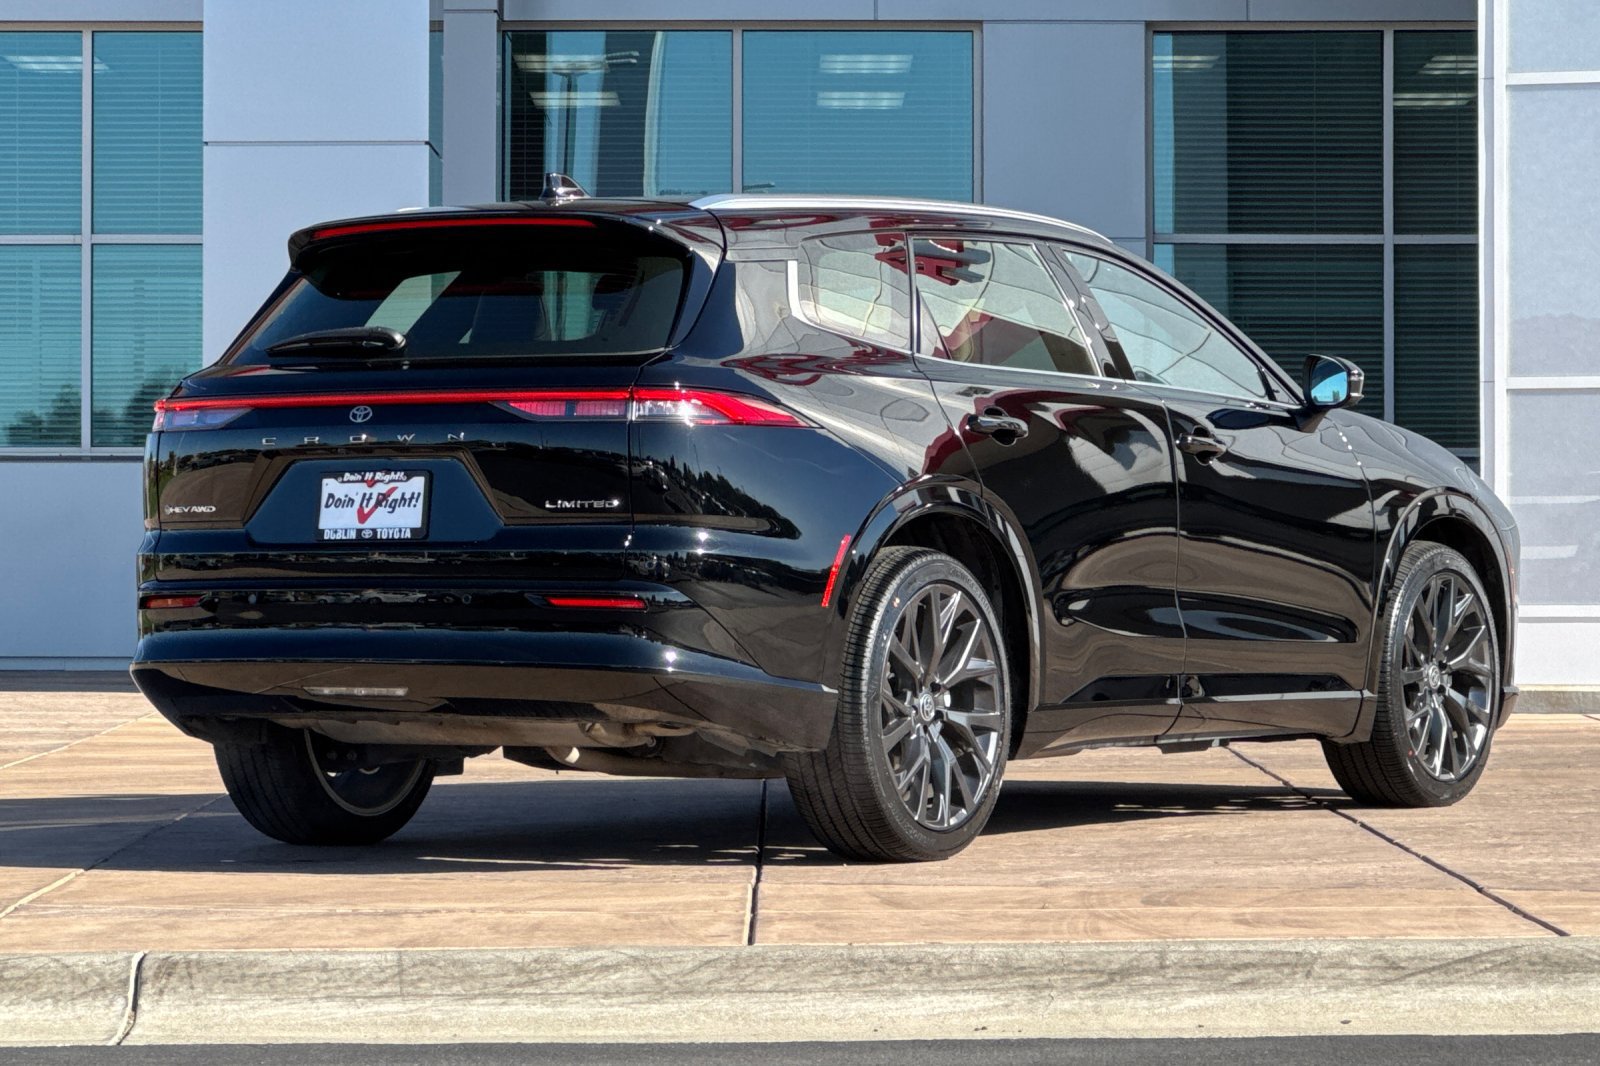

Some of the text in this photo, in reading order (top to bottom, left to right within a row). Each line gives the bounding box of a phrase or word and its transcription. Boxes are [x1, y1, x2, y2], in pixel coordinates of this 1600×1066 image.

[261, 432, 465, 446] CROWN
[343, 472, 364, 481] Doin'
[364, 472, 374, 481] It
[324, 491, 421, 513] Doin' It Right!
[544, 499, 620, 509] LIMITED
[323, 528, 411, 539] DUBLIN TOYOTA
